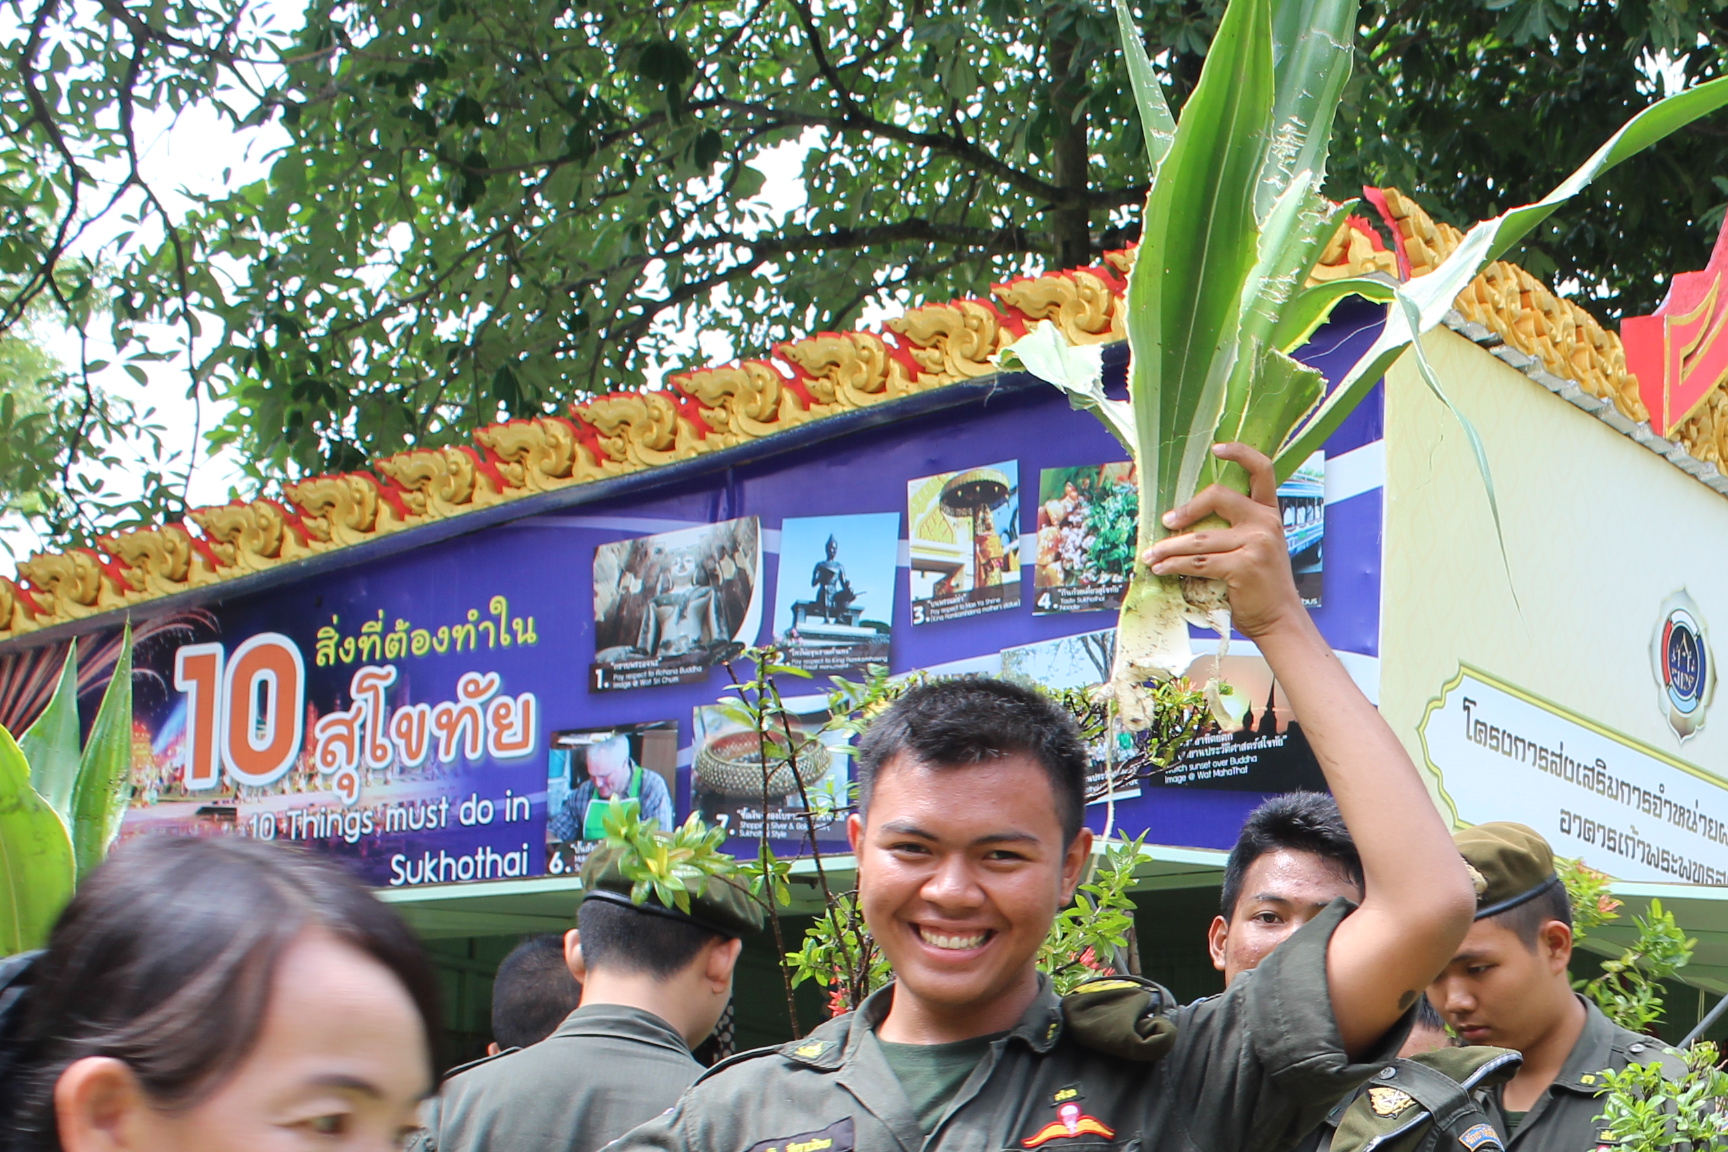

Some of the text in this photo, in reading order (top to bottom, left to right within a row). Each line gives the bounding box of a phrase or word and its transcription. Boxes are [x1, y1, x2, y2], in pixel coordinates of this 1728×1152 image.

[1037, 592, 1058, 610] 4.
[913, 605, 930, 625] 3.
[316, 596, 537, 666] สิ่งที่ต้องทำใน
[595, 668, 610, 690] 1.
[175, 632, 304, 790] 10
[315, 665, 536, 805] สุโขทัย
[1188, 760, 1211, 771] sunset
[1213, 758, 1229, 768] over
[1230, 754, 1258, 765] Buddha
[1165, 774, 1186, 784] Image
[1197, 769, 1212, 780] Wat
[249, 789, 531, 844] 10 Things must do in
[740, 821, 769, 831] Shoppig
[390, 843, 529, 886] Sukhothai
[549, 851, 571, 874] 6.
